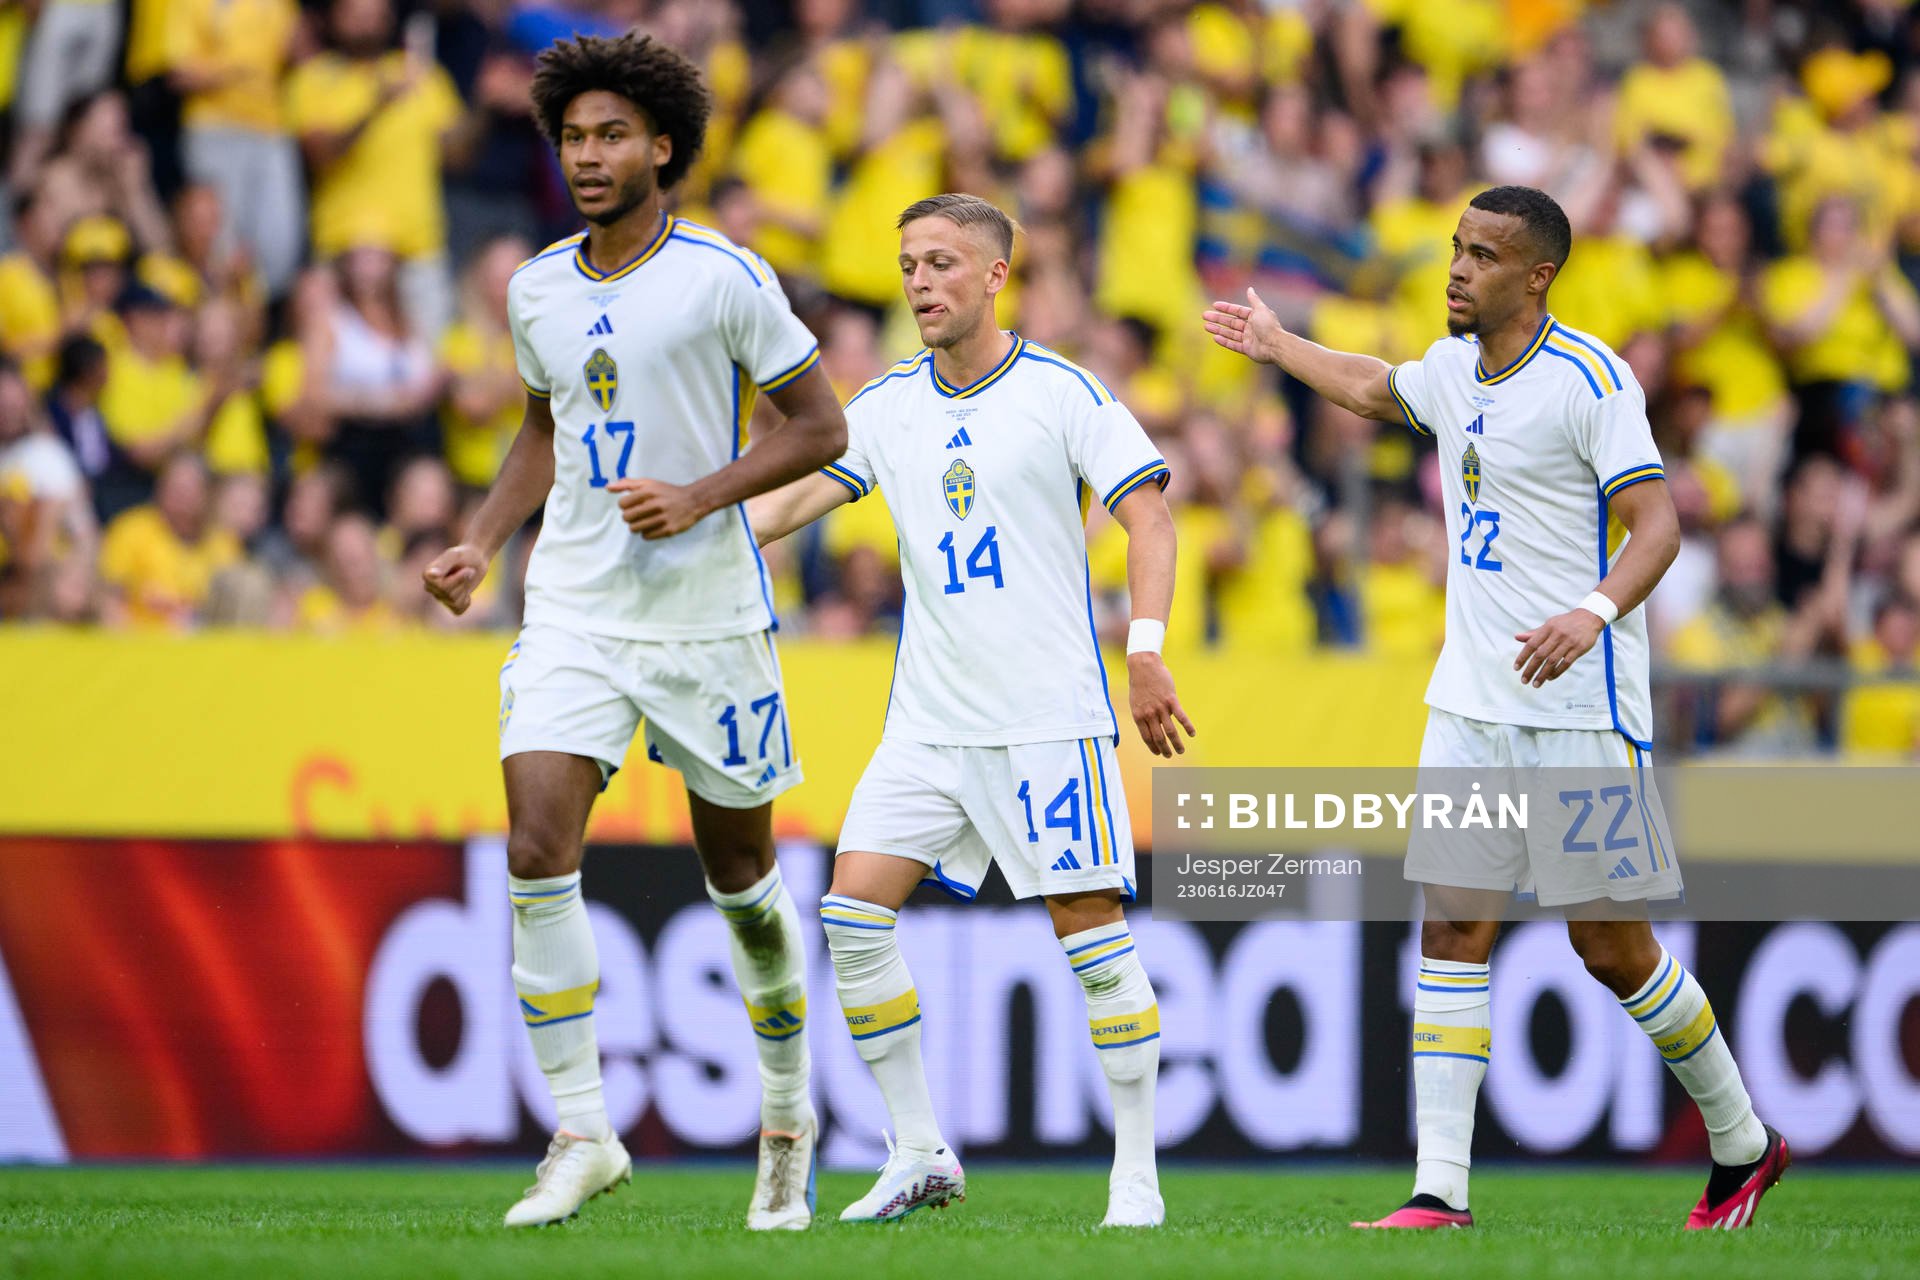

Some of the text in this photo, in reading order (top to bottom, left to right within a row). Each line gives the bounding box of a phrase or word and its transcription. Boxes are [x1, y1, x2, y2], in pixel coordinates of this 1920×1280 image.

[581, 421, 635, 488] 17
[937, 525, 1005, 595] 14
[1461, 501, 1503, 572] 22
[718, 692, 779, 767] 17
[1017, 777, 1082, 843] 14
[1558, 784, 1639, 853] 22
[1396, 846, 1698, 1155] or
